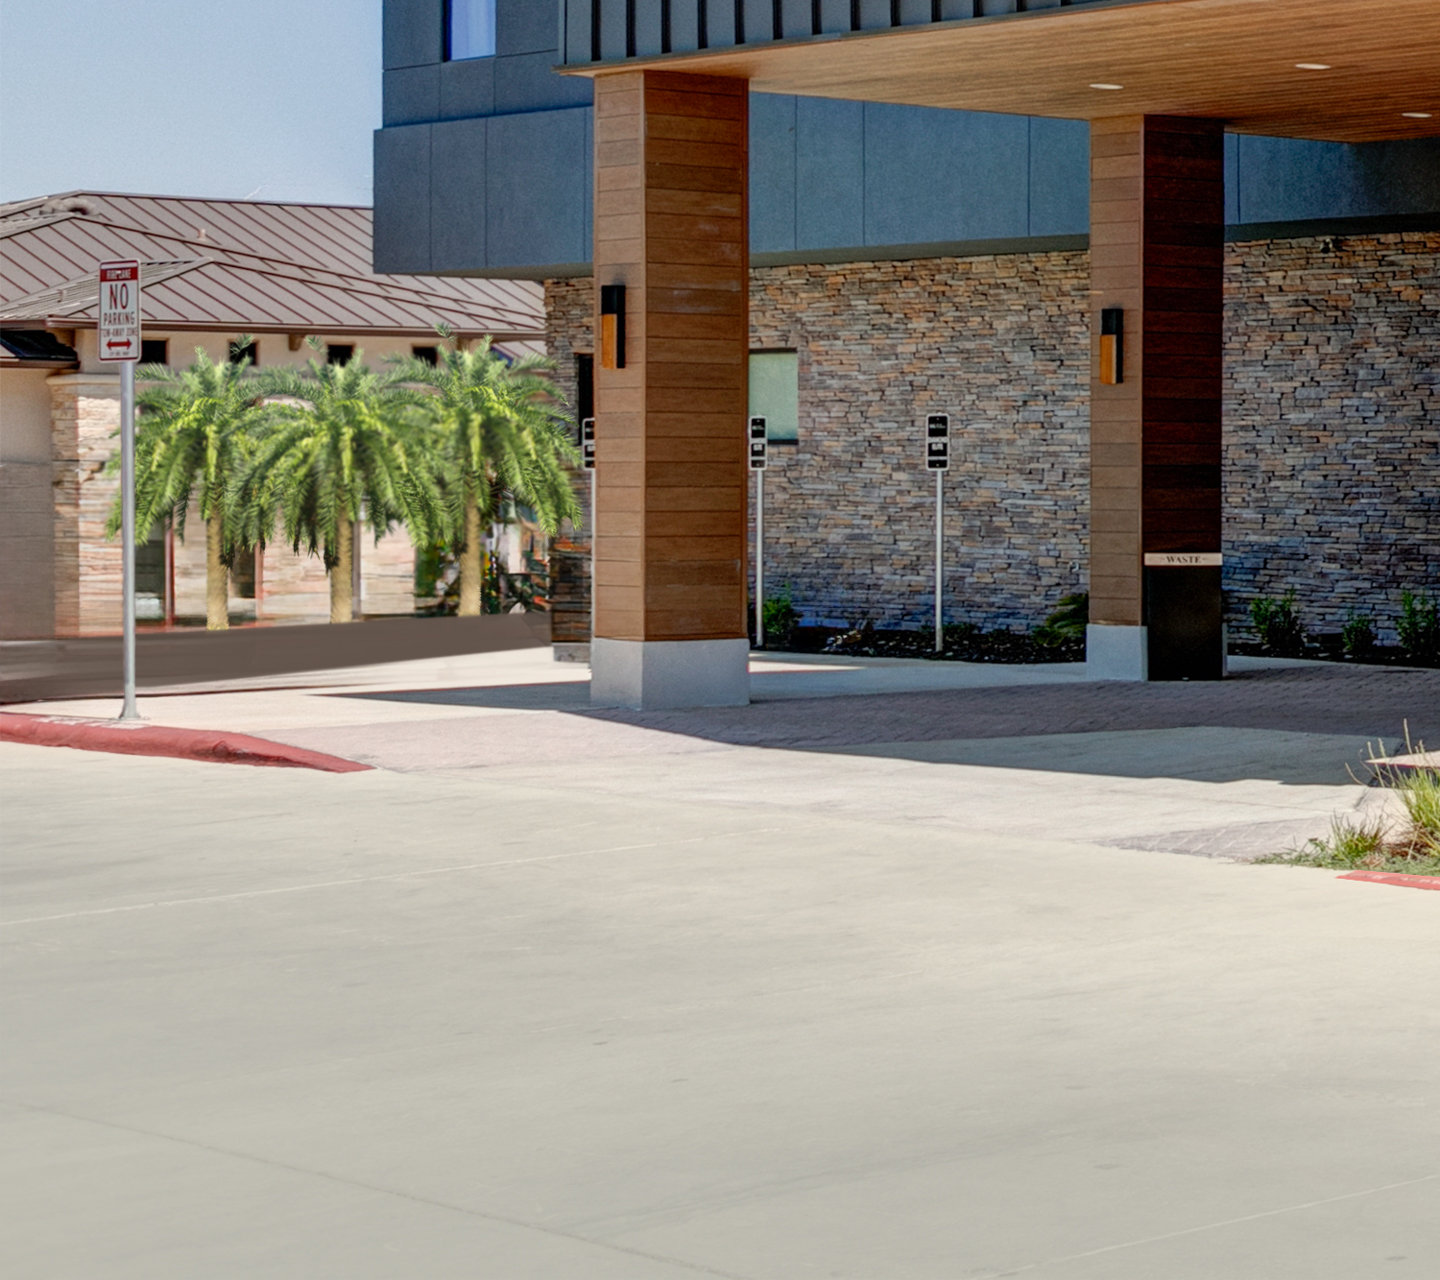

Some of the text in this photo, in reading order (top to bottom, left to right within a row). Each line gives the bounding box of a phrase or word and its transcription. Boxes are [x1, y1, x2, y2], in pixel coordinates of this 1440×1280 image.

[109, 283, 129, 310] NO
[103, 311, 135, 326] PARKING
[1166, 555, 1202, 564] WASTE
